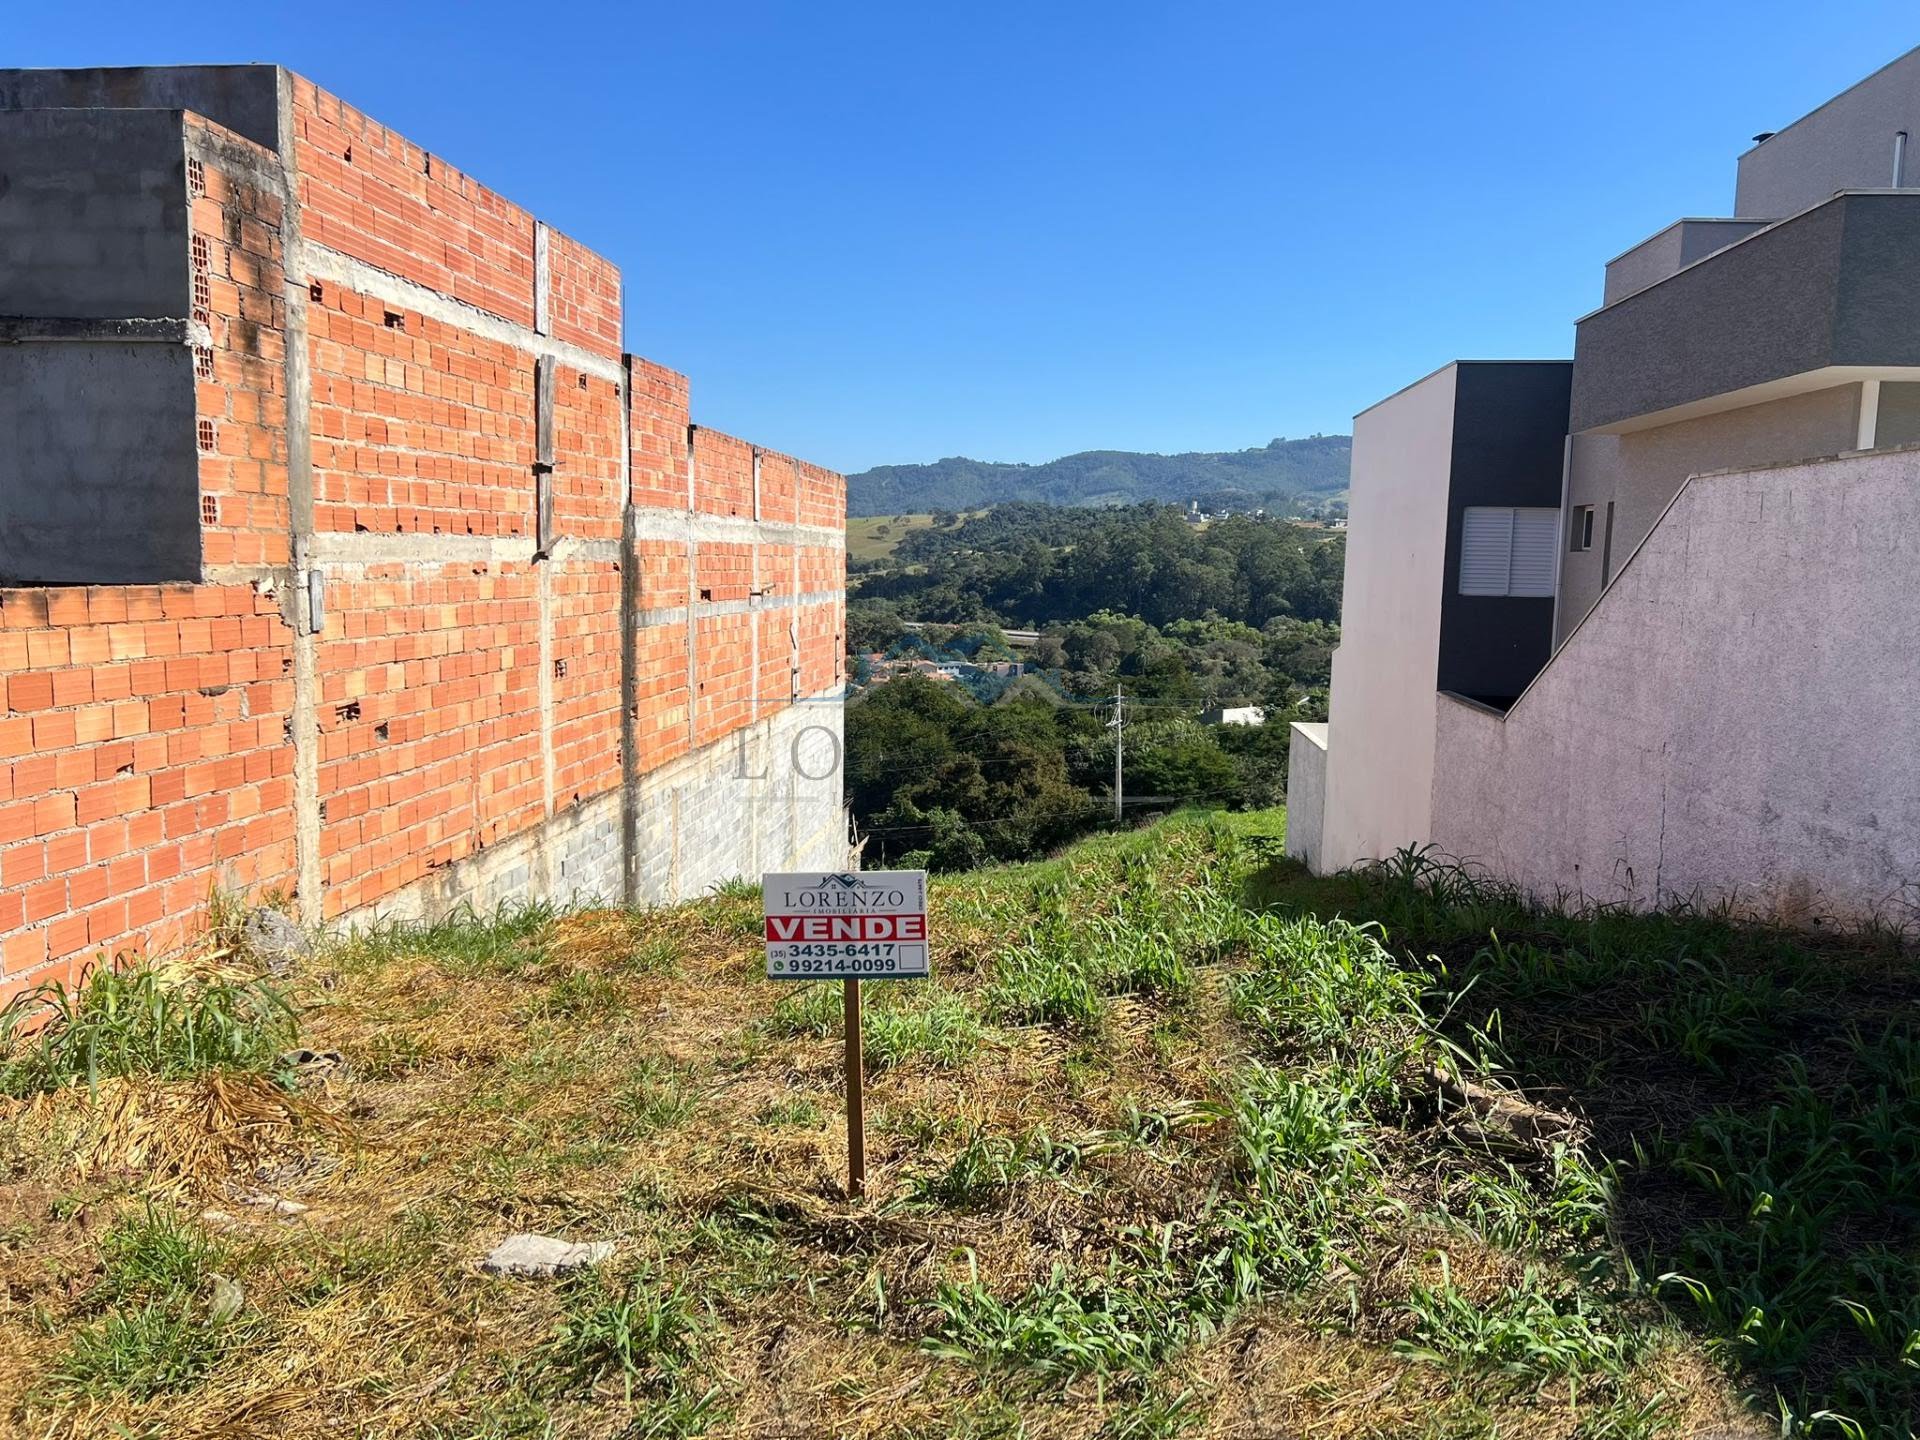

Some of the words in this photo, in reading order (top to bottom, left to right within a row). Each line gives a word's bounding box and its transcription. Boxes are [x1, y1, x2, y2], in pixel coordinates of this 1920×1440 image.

[784, 890, 904, 908] LORENZO
[770, 916, 922, 939] VENDE
[770, 950, 786, 959] (35)
[789, 943, 895, 957] 3435-6417
[789, 958, 896, 972] 99214-0099
